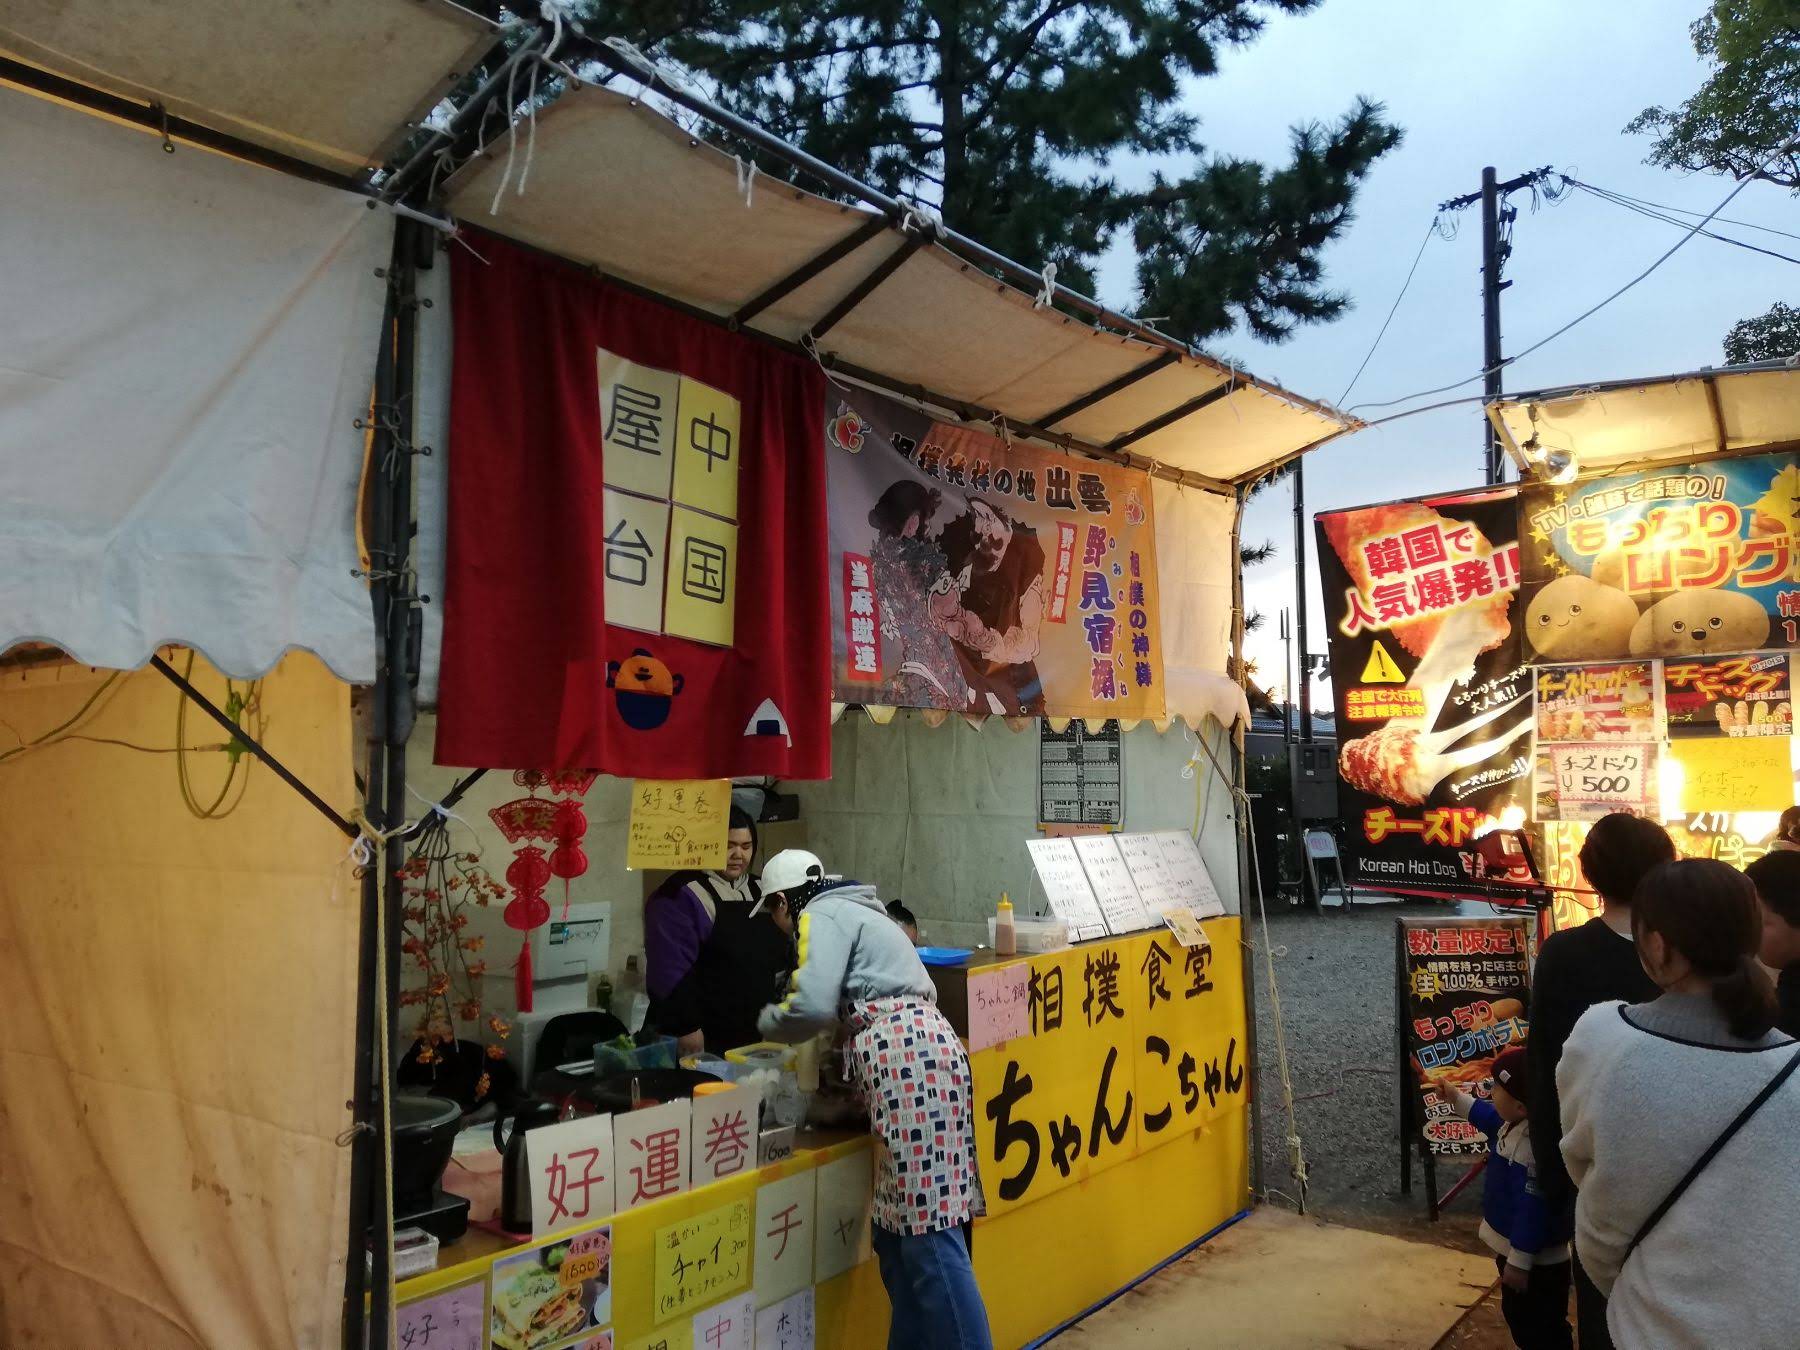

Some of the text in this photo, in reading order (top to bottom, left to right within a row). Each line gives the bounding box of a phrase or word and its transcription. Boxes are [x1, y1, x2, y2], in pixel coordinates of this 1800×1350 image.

[603, 382, 663, 588] 屋台
[682, 411, 732, 605] 中国
[1045, 466, 1112, 515] 出雲
[1364, 524, 1475, 579] 韓国で
[1128, 550, 1153, 689] 相撲の神様
[1359, 858, 1405, 874] Korean
[1409, 859, 1430, 875] Hot
[1433, 861, 1457, 878] Dog
[1408, 929, 1526, 954] 数量限定!
[1417, 973, 1435, 992] 生
[1441, 973, 1484, 989] 100%
[1413, 1000, 1494, 1041] もっちり
[1416, 1016, 1530, 1070] ロングポテト
